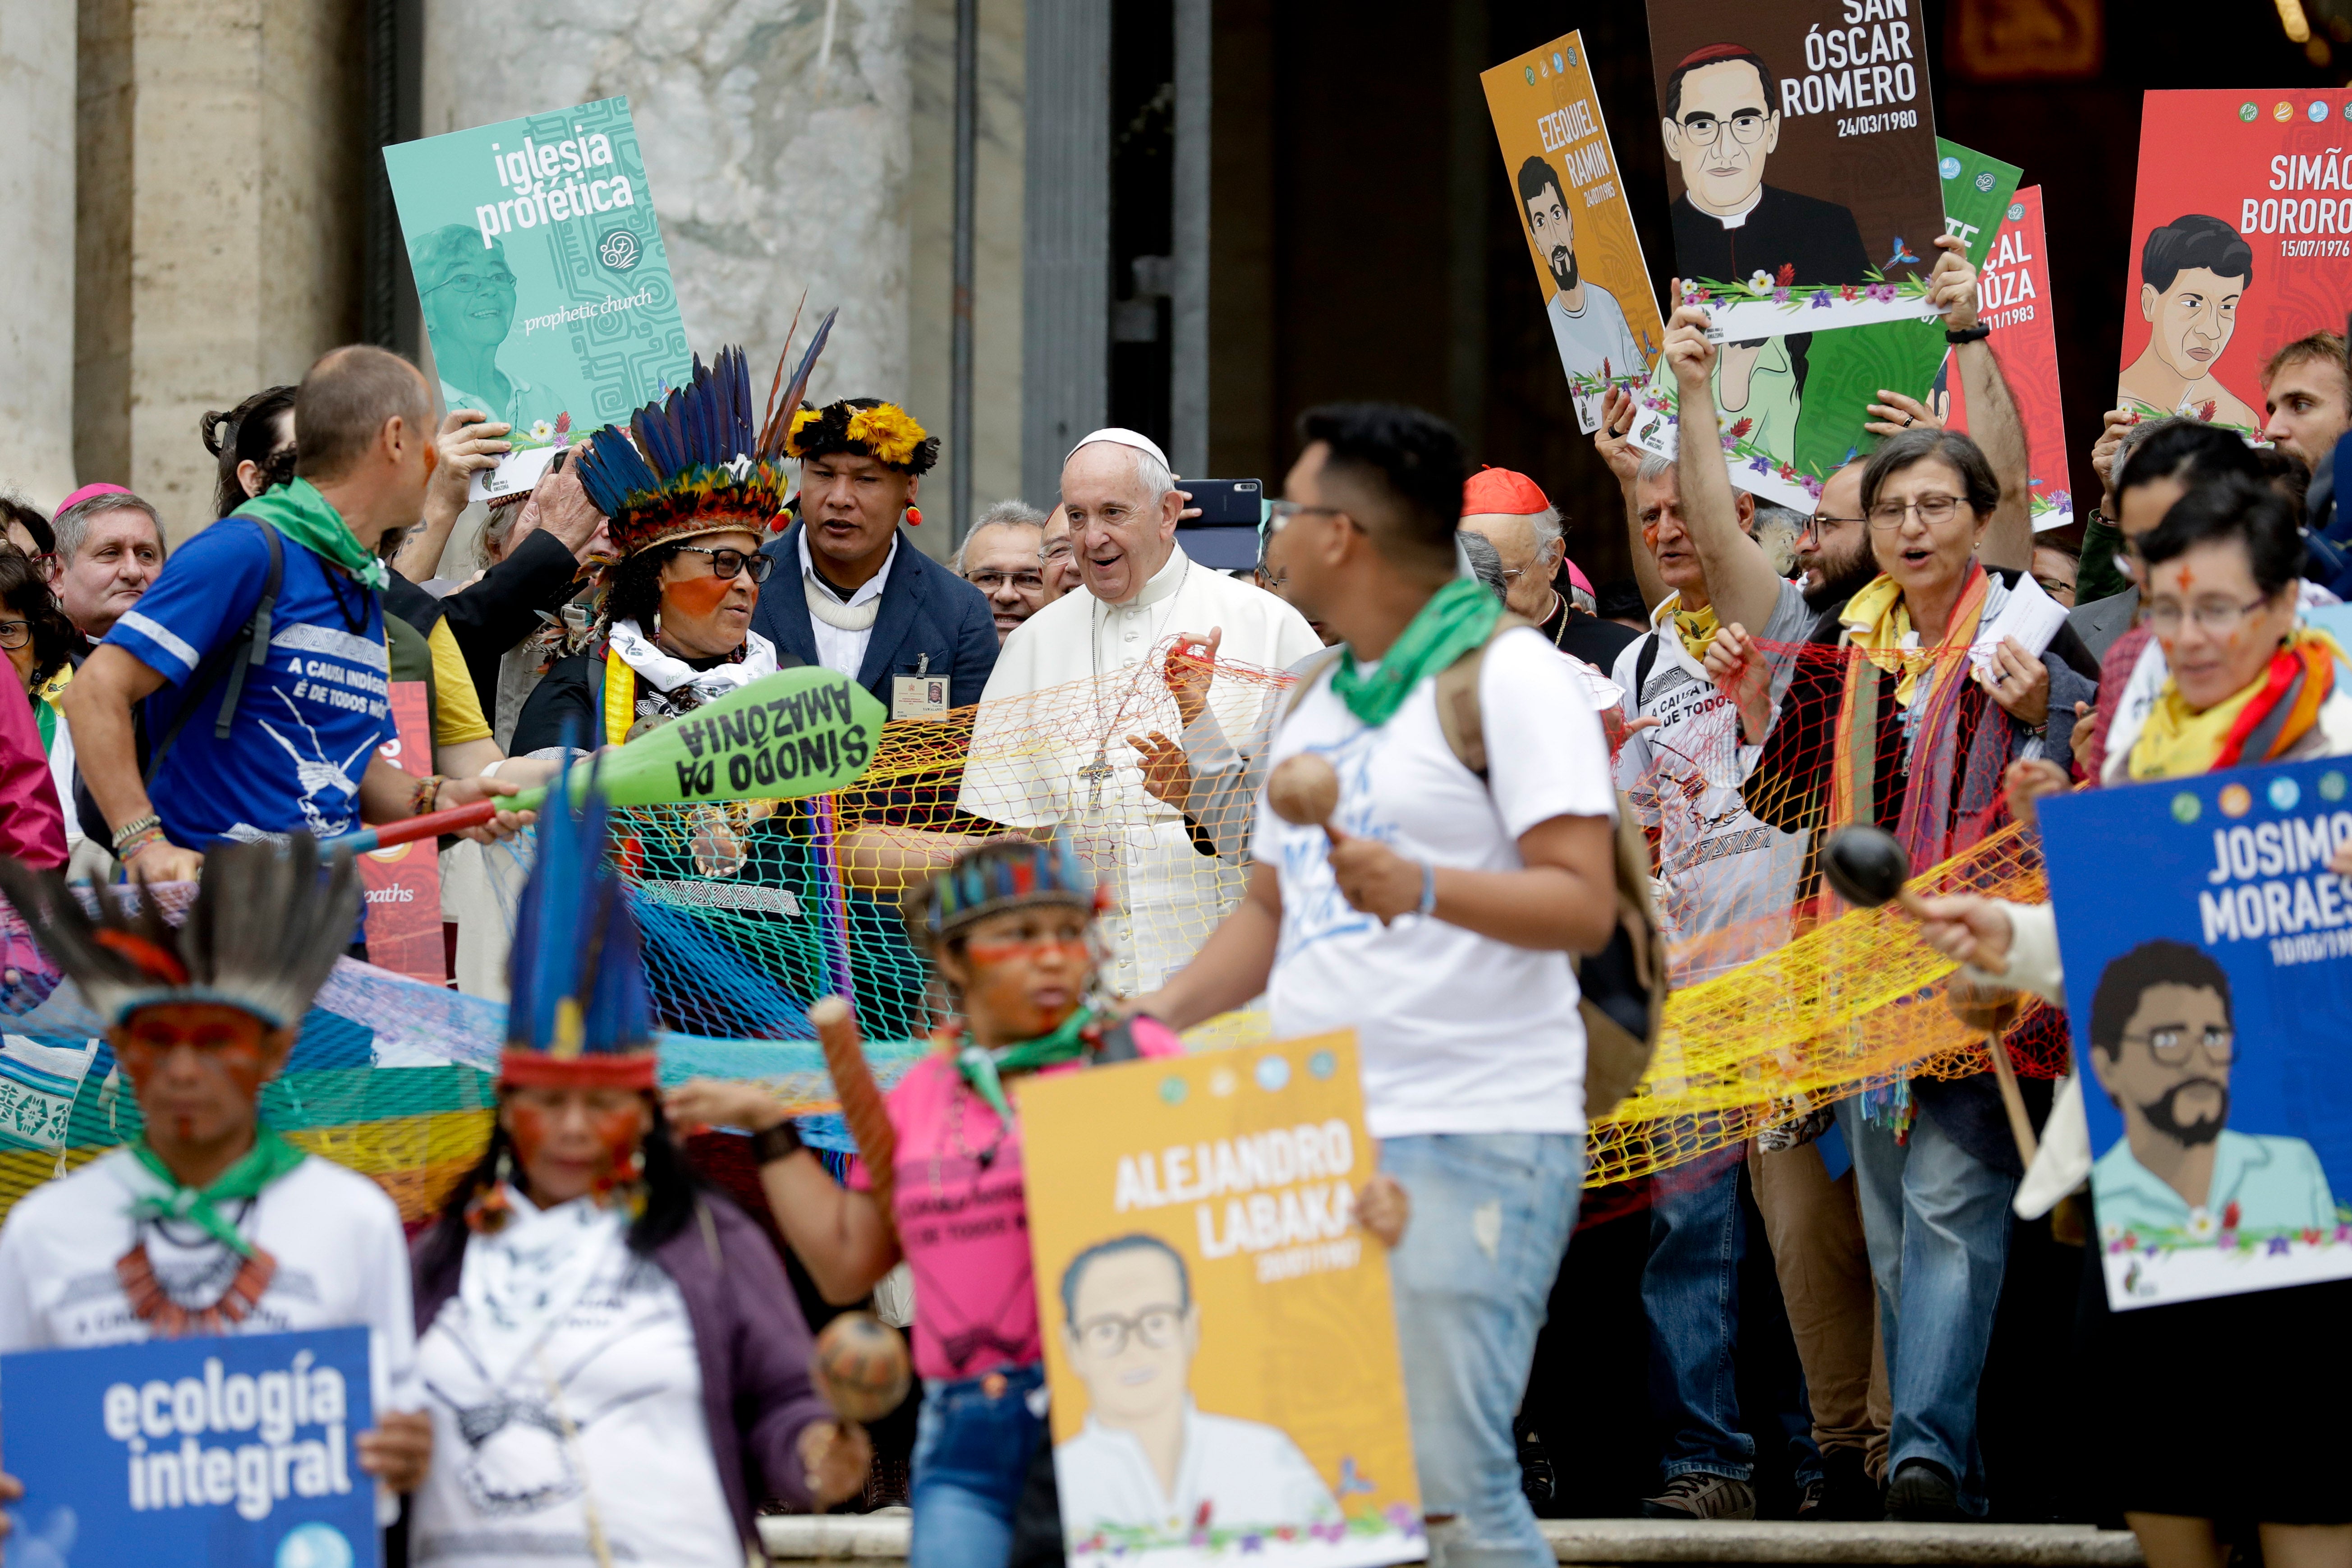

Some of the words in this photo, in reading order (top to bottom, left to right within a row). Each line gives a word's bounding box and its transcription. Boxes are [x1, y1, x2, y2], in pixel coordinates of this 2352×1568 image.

[1805, 21, 1913, 72] ÓSCAR
[1781, 63, 1917, 118] ROMERO
[1537, 99, 1599, 153] EZEQUIEL
[1838, 109, 1917, 137] 24/03/1980
[492, 125, 613, 194] iglesia
[1565, 139, 1610, 189] RAMIN
[475, 175, 634, 249] profética
[1584, 181, 1616, 207] 24/07/1985
[2241, 198, 2352, 234] BORORO
[2281, 240, 2350, 257] 15/07/1976
[524, 301, 598, 336] prophetic
[601, 288, 652, 315] church
[287, 657, 303, 675] A
[293, 678, 308, 698] É
[308, 684, 329, 703] DE
[330, 689, 368, 713] TODOS
[678, 680, 851, 759] AMAZÔNIA
[1684, 695, 1733, 717] TODO
[677, 759, 714, 797] DA
[729, 724, 868, 791] SÍNODO
[1116, 1119, 1353, 1212] ALEJANDRO
[1197, 1182, 1358, 1259] LABAKA
[103, 1348, 346, 1442] ecología
[127, 1422, 352, 1521] integral
